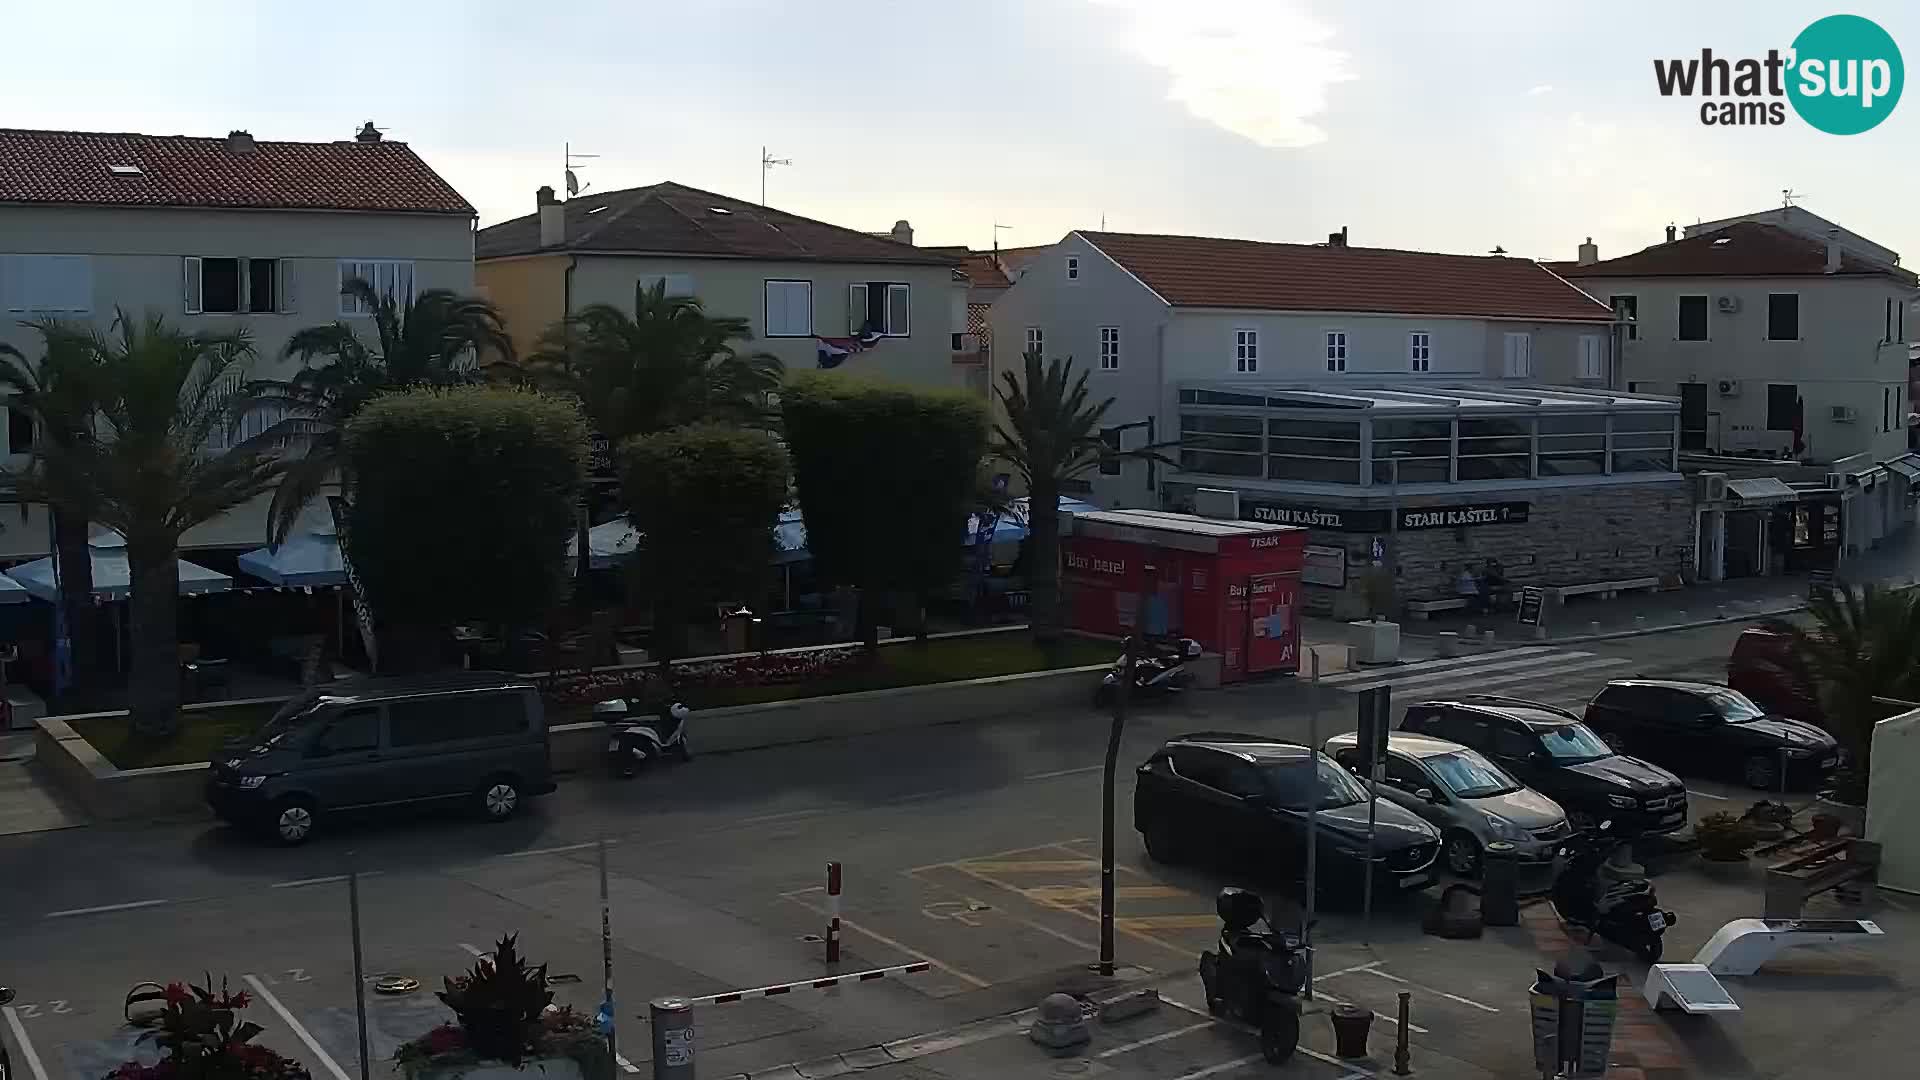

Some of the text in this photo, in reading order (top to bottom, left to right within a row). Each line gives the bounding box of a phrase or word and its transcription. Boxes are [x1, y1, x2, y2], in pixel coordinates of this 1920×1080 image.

[1254, 507, 1343, 527] STARI KAŠTEL
[1404, 512, 1444, 527] STARI
[1447, 507, 1498, 524] KAŠTEL
[1229, 584, 1248, 597] Buy
